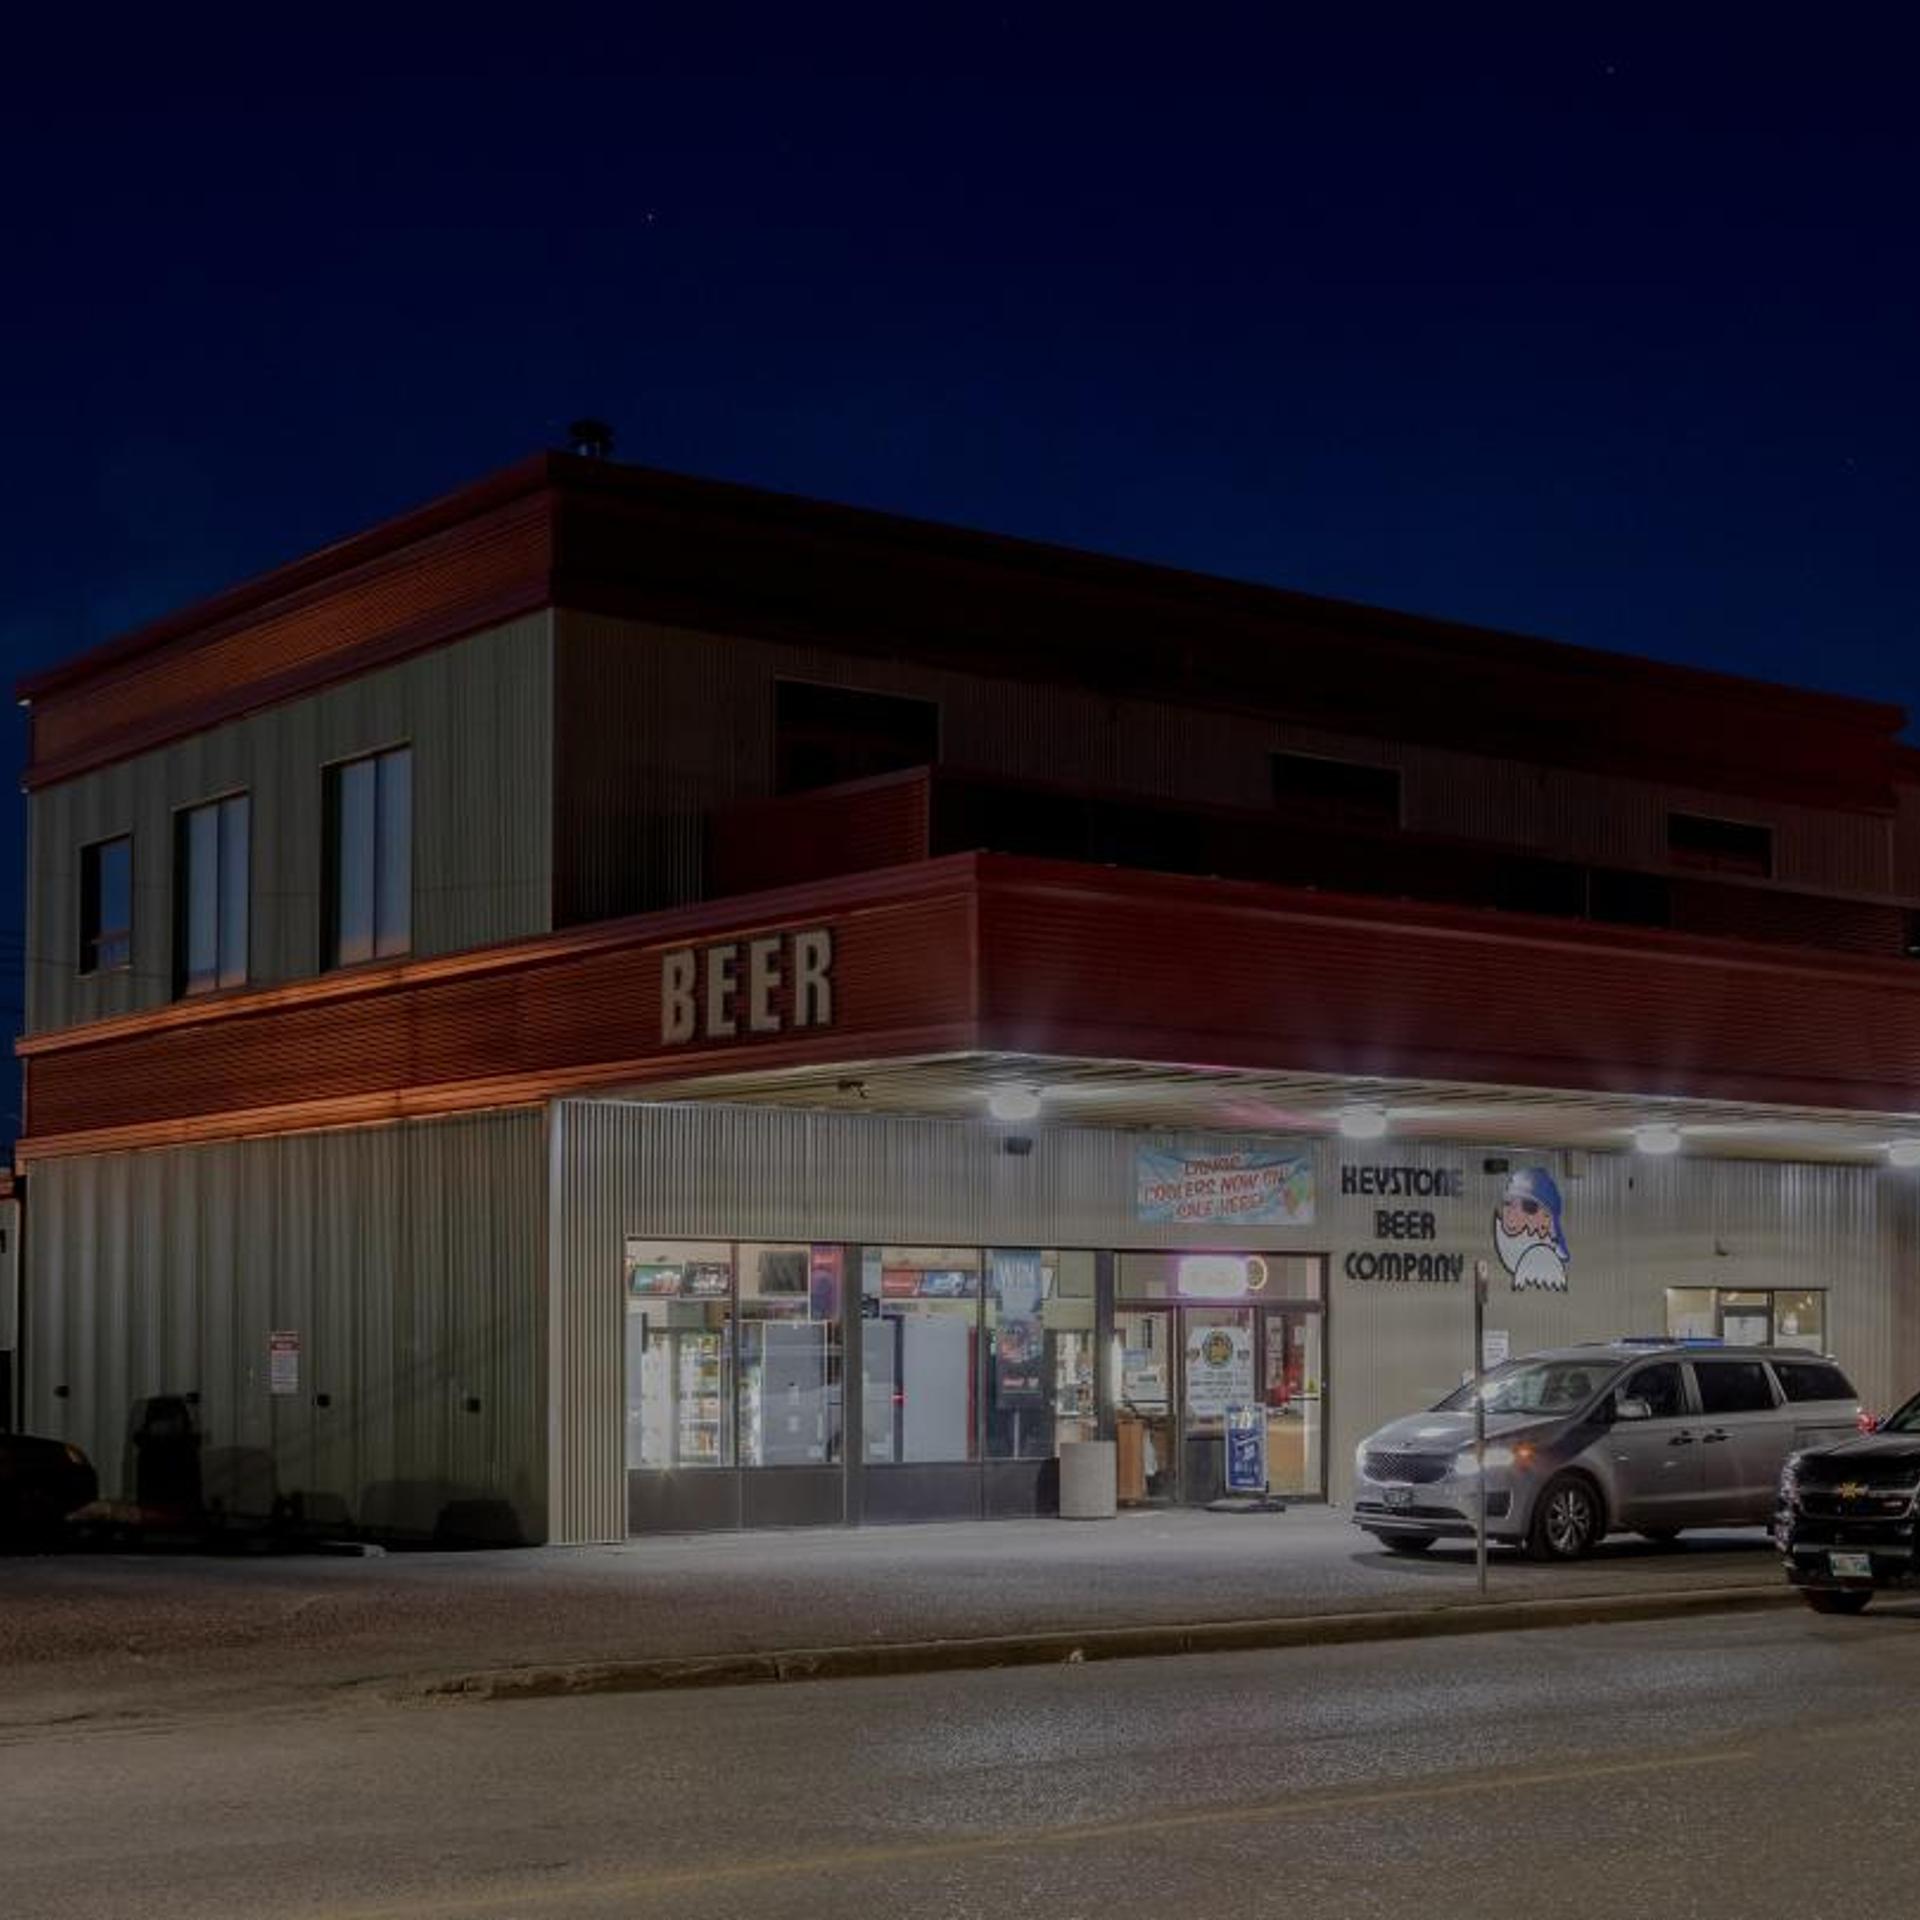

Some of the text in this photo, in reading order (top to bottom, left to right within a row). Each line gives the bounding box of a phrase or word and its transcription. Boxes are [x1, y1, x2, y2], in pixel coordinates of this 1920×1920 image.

[660, 926, 834, 1046] BEER
[1220, 1172, 1258, 1197] NOW
[1341, 1164, 1464, 1197] KEYSTONE
[1374, 1209, 1436, 1240] BEER
[1345, 1252, 1464, 1283] COMPANY
